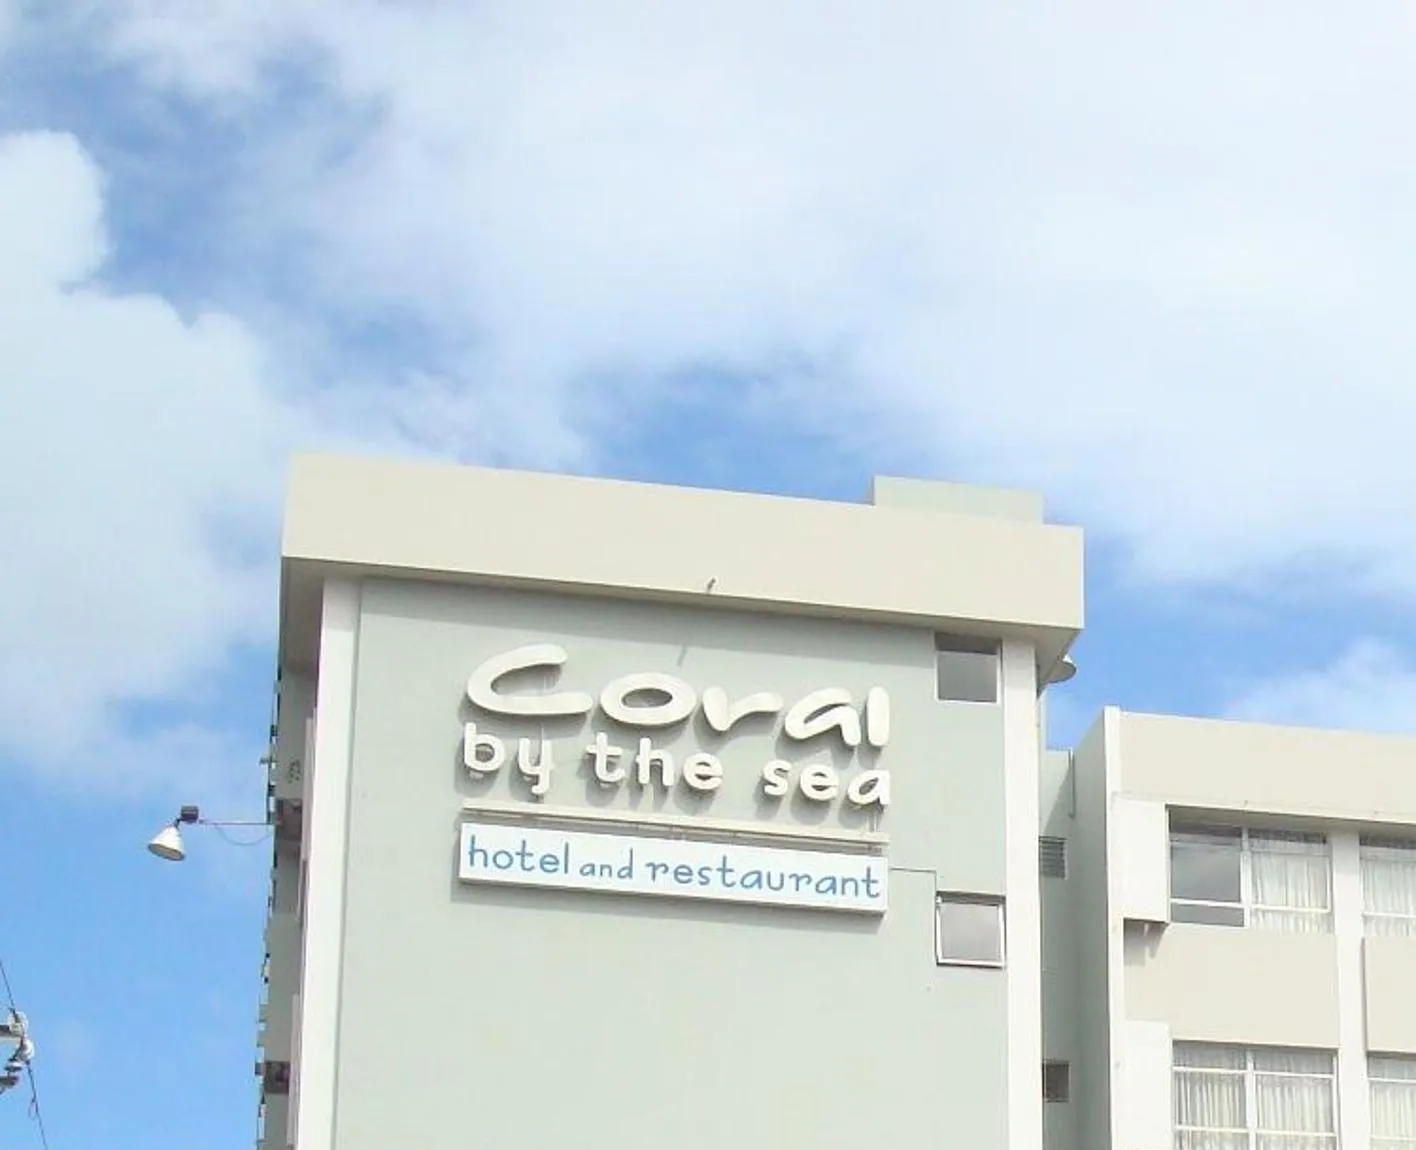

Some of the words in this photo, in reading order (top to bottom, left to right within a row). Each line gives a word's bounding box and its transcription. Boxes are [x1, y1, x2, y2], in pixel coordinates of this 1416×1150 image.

[467, 643, 890, 748] Coral
[463, 722, 553, 795] by
[586, 732, 724, 790] the
[763, 758, 891, 805] sea
[467, 834, 571, 876] hotel
[580, 848, 635, 881] and
[645, 854, 882, 899] restaurant
